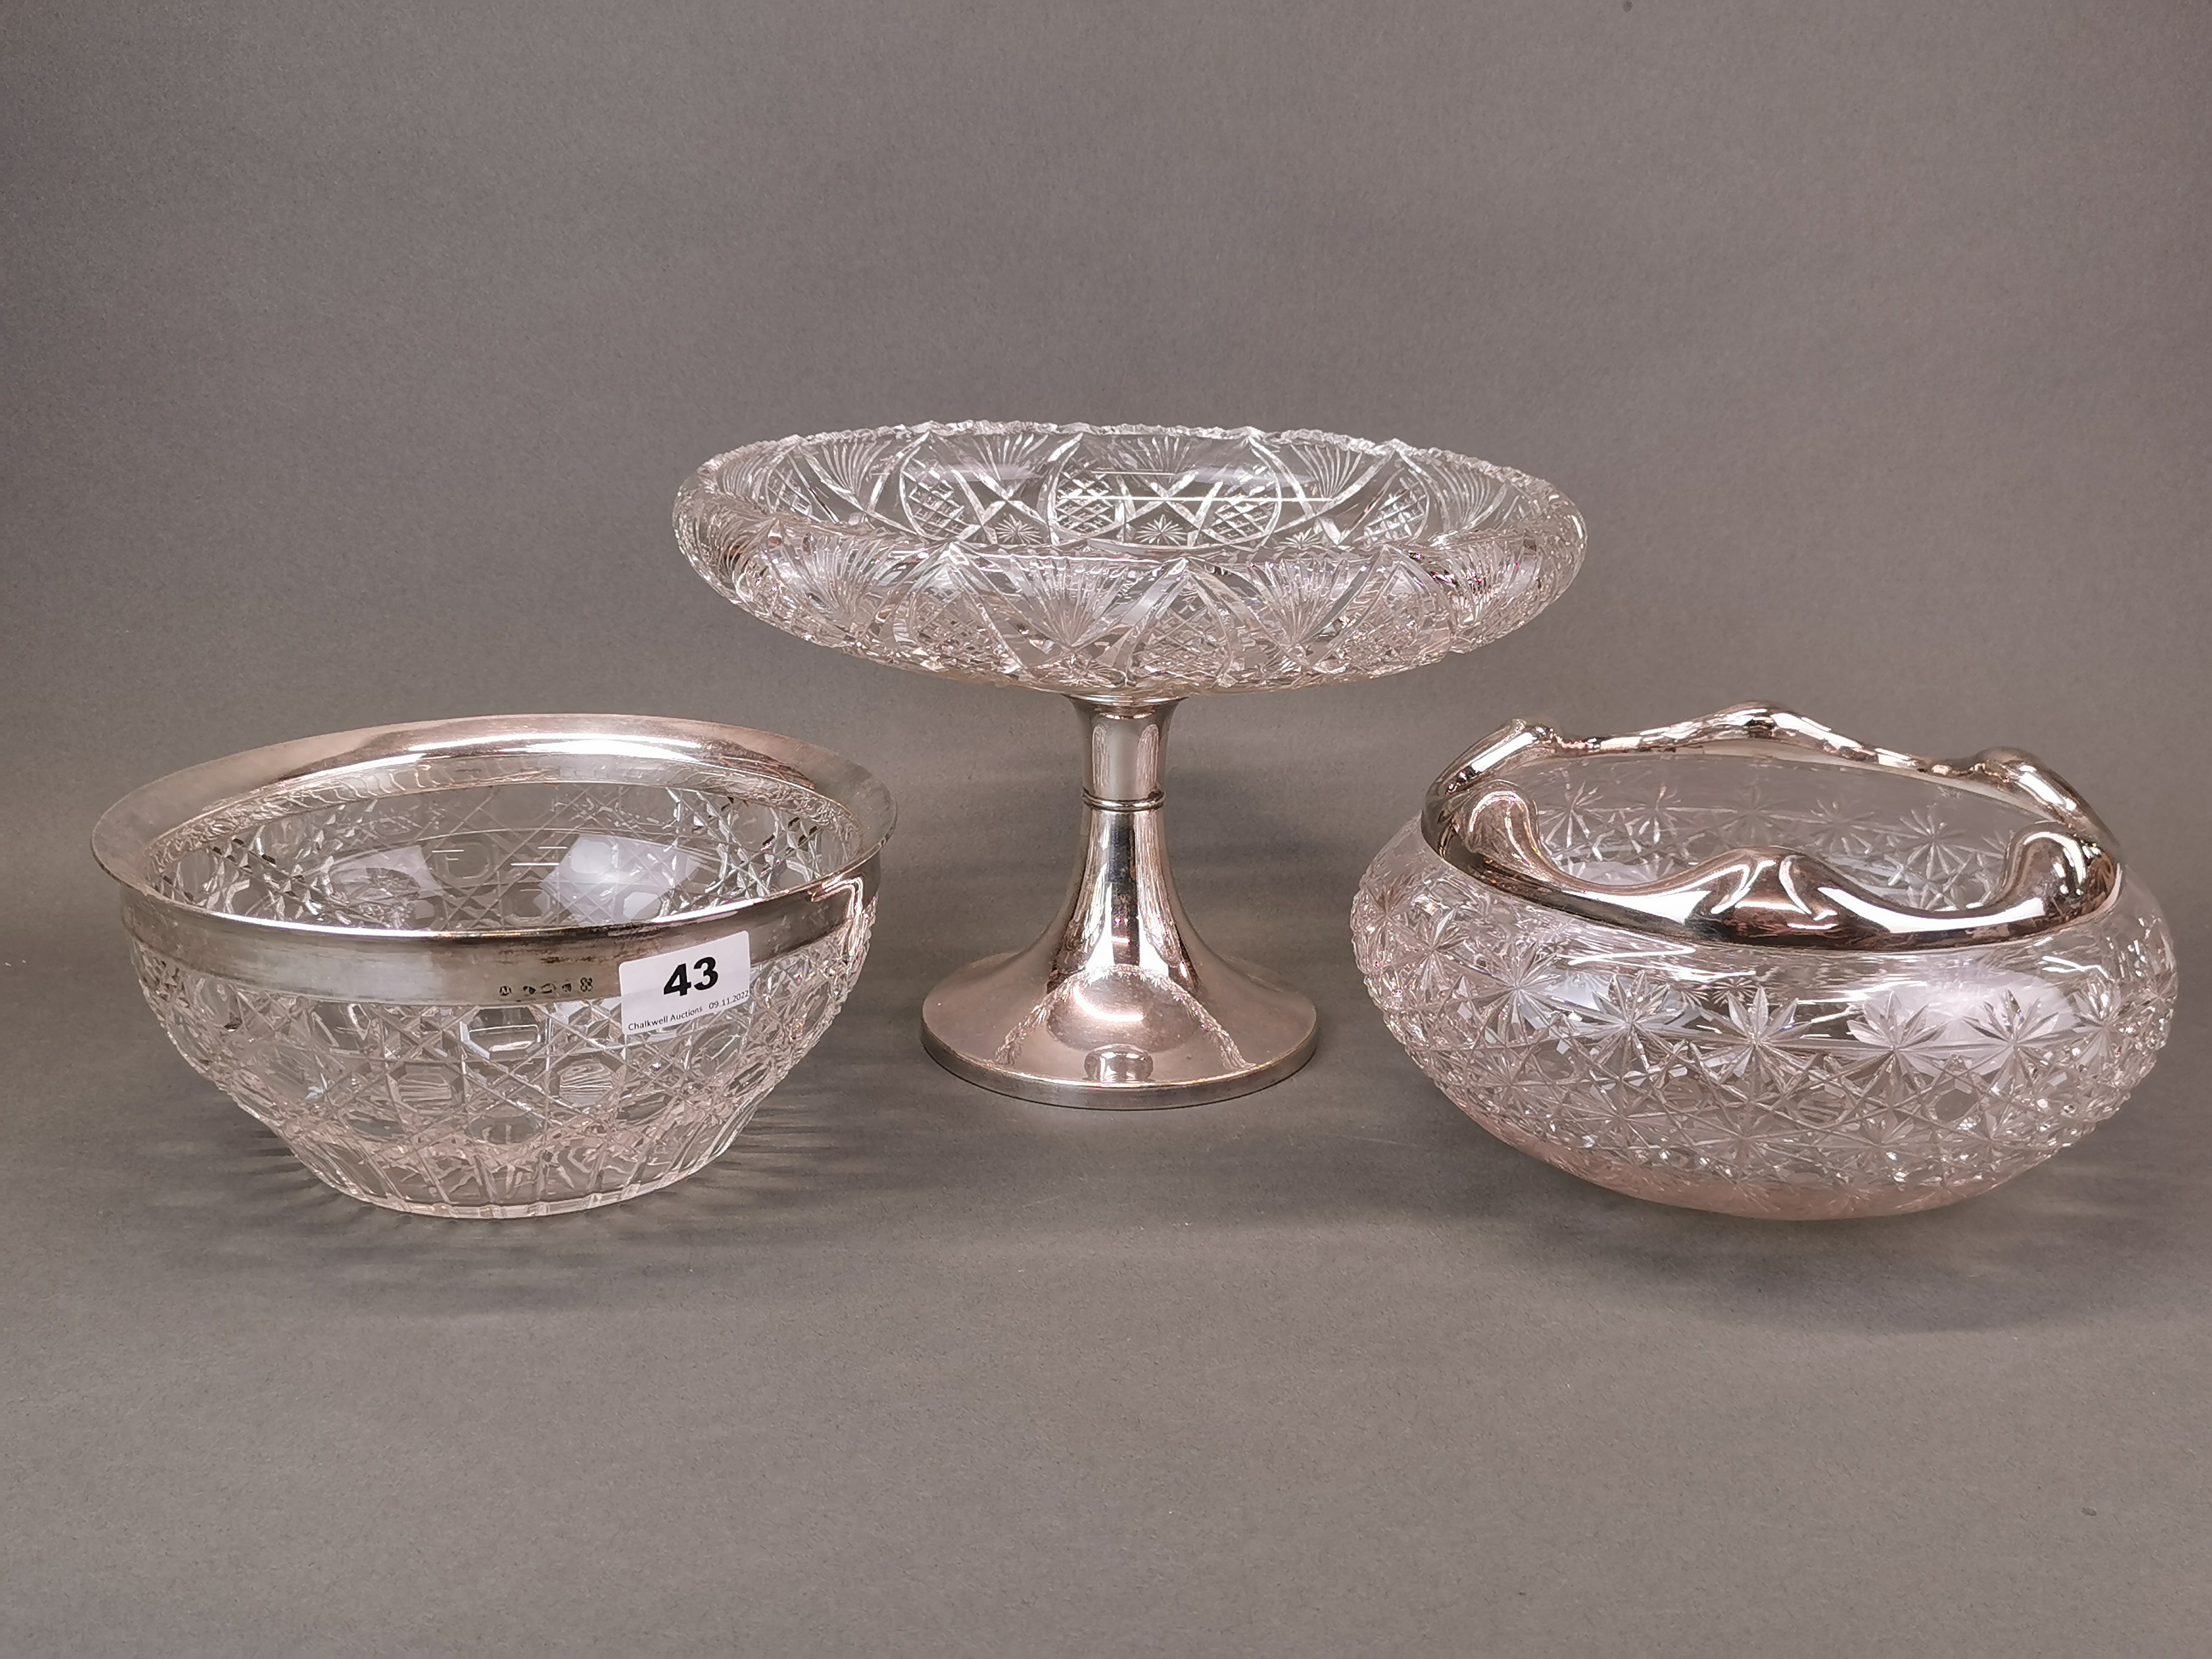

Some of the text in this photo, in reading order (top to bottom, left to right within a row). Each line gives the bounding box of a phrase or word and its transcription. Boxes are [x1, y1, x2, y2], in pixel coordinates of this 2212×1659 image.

[663, 956, 719, 996] 43
[628, 990, 749, 1031] Chalkwell Auctions 09.11.2022
